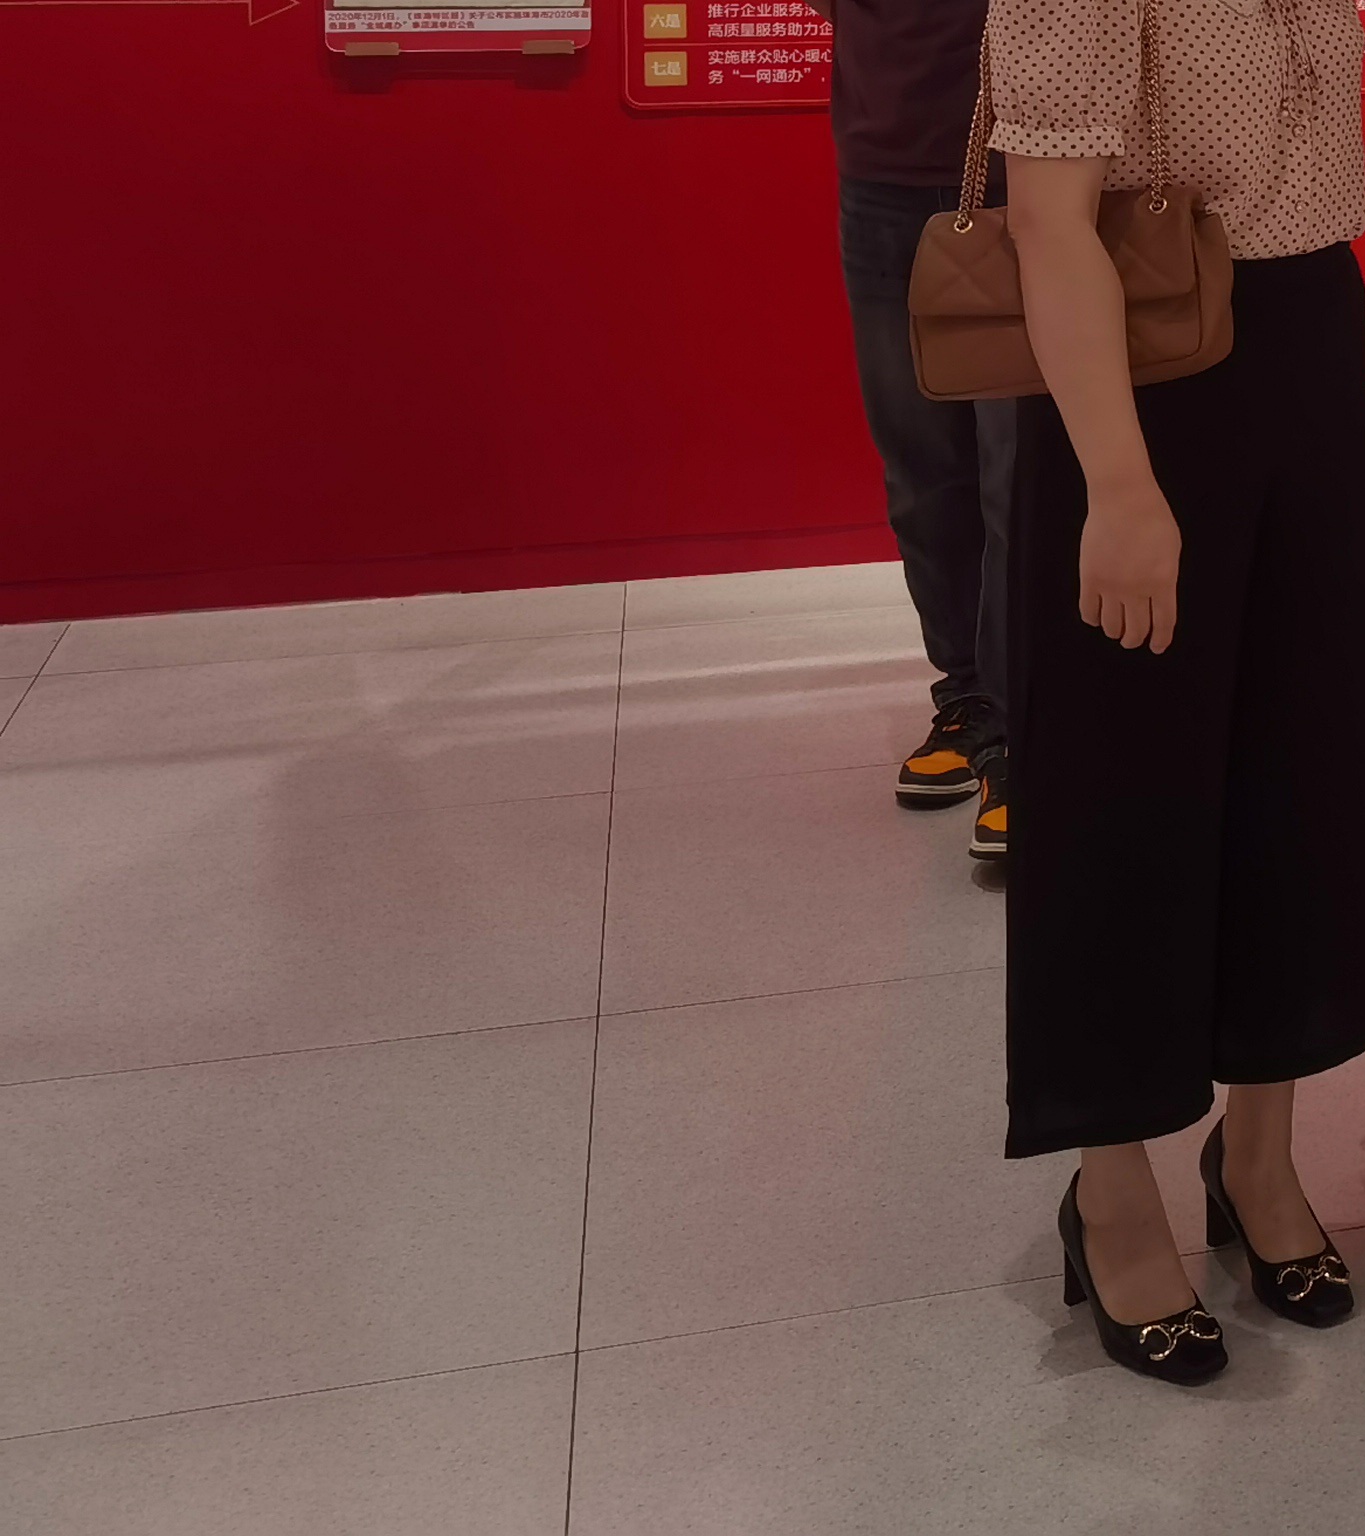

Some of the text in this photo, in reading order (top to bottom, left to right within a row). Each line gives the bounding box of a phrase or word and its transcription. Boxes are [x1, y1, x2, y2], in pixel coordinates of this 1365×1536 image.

[707, 22, 834, 38] 高质量服务助力企
[708, 49, 833, 65] 实施群众贴心暖心
